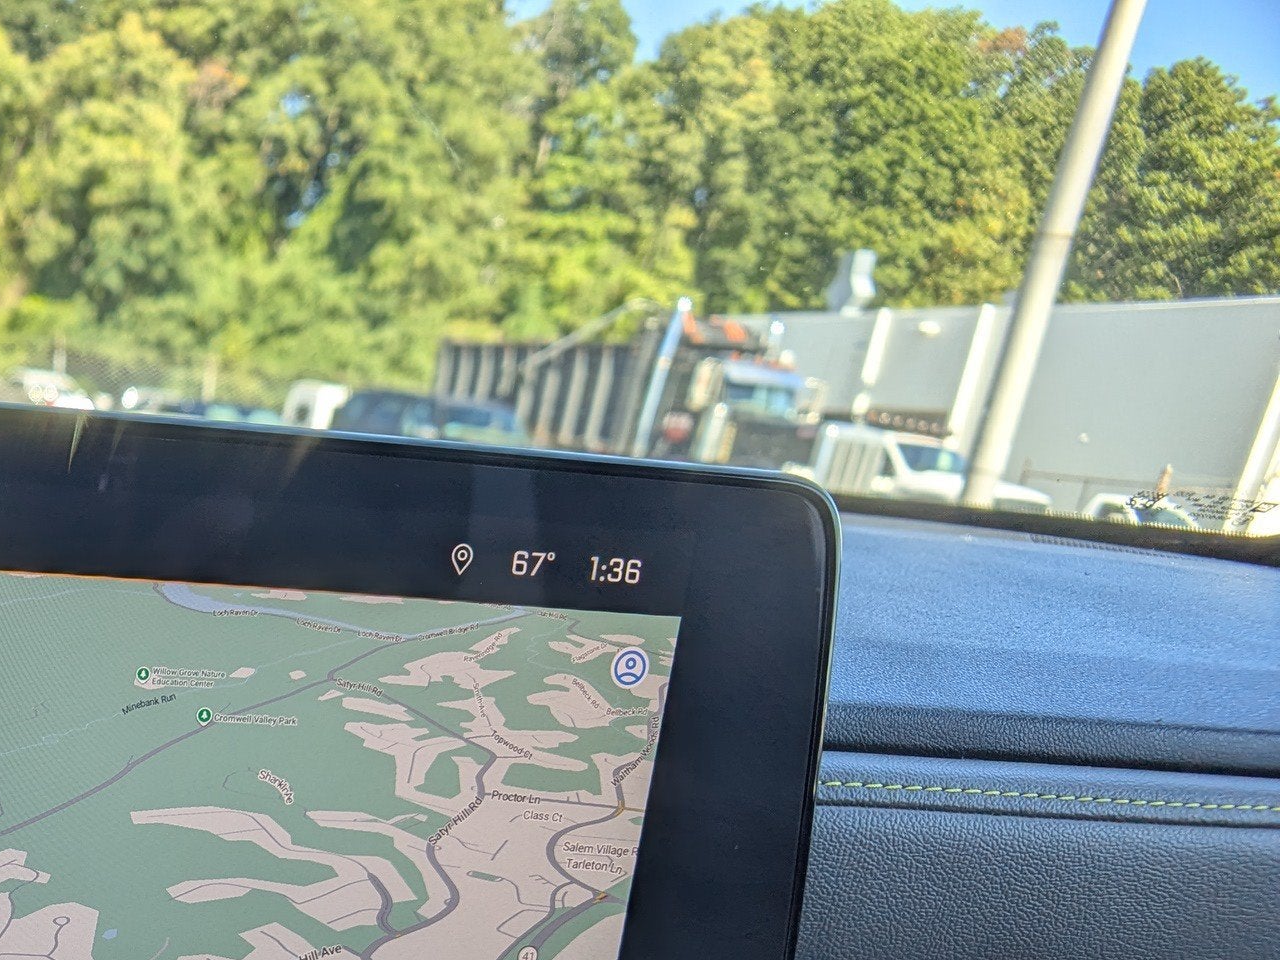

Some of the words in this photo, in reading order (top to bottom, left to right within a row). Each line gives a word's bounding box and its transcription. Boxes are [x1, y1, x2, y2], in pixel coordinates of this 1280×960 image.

[511, 550, 556, 577] 67°
[589, 556, 642, 584] 1:36
[153, 667, 177, 676] Willow
[178, 669, 199, 677] Grove
[201, 670, 226, 678] Nature
[152, 678, 188, 686] Education
[191, 679, 214, 688] Center
[371, 686, 383, 697] Rd
[121, 697, 160, 715] Minebank
[160, 693, 177, 704] Run
[214, 714, 252, 723] Cromwell
[254, 715, 277, 726] Valley
[278, 717, 297, 725] Park
[491, 729, 524, 757] Topwood
[491, 790, 526, 803] Proctor
[528, 793, 541, 805] Ln
[428, 820, 454, 846] Satyr
[451, 808, 472, 825] Hill
[469, 796, 484, 810] Rd
[523, 810, 549, 821] Class
[552, 812, 563, 822] Ct
[562, 841, 593, 855] Salem
[596, 843, 628, 857] Village
[566, 858, 609, 873] Tarleton
[609, 863, 623, 875] Ln
[321, 944, 342, 959] Ave
[522, 951, 535, 960] 41
